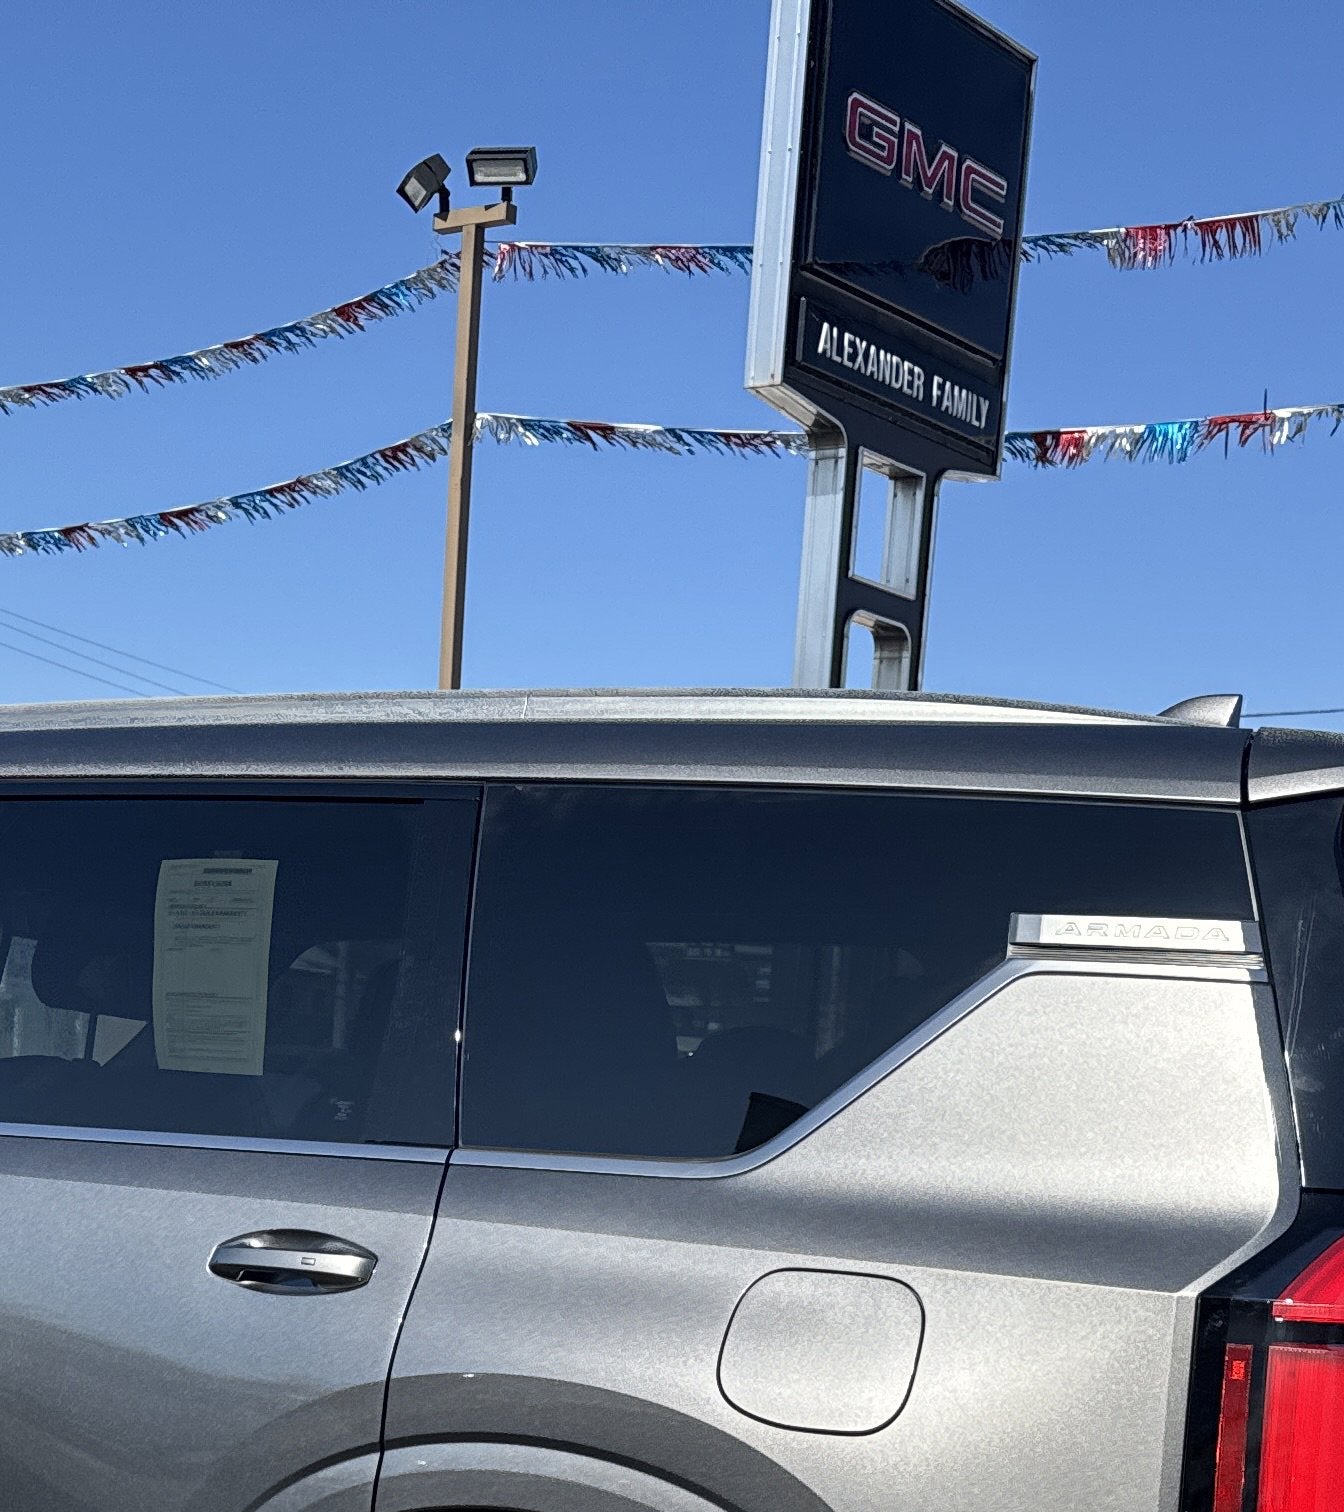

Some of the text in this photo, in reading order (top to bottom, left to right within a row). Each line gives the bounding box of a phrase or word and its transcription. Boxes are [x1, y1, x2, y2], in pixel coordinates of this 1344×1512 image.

[846, 92, 1007, 236] GMC
[817, 321, 990, 430] ALEXANDER FAMILY
[1055, 921, 1230, 942] ARMADA
